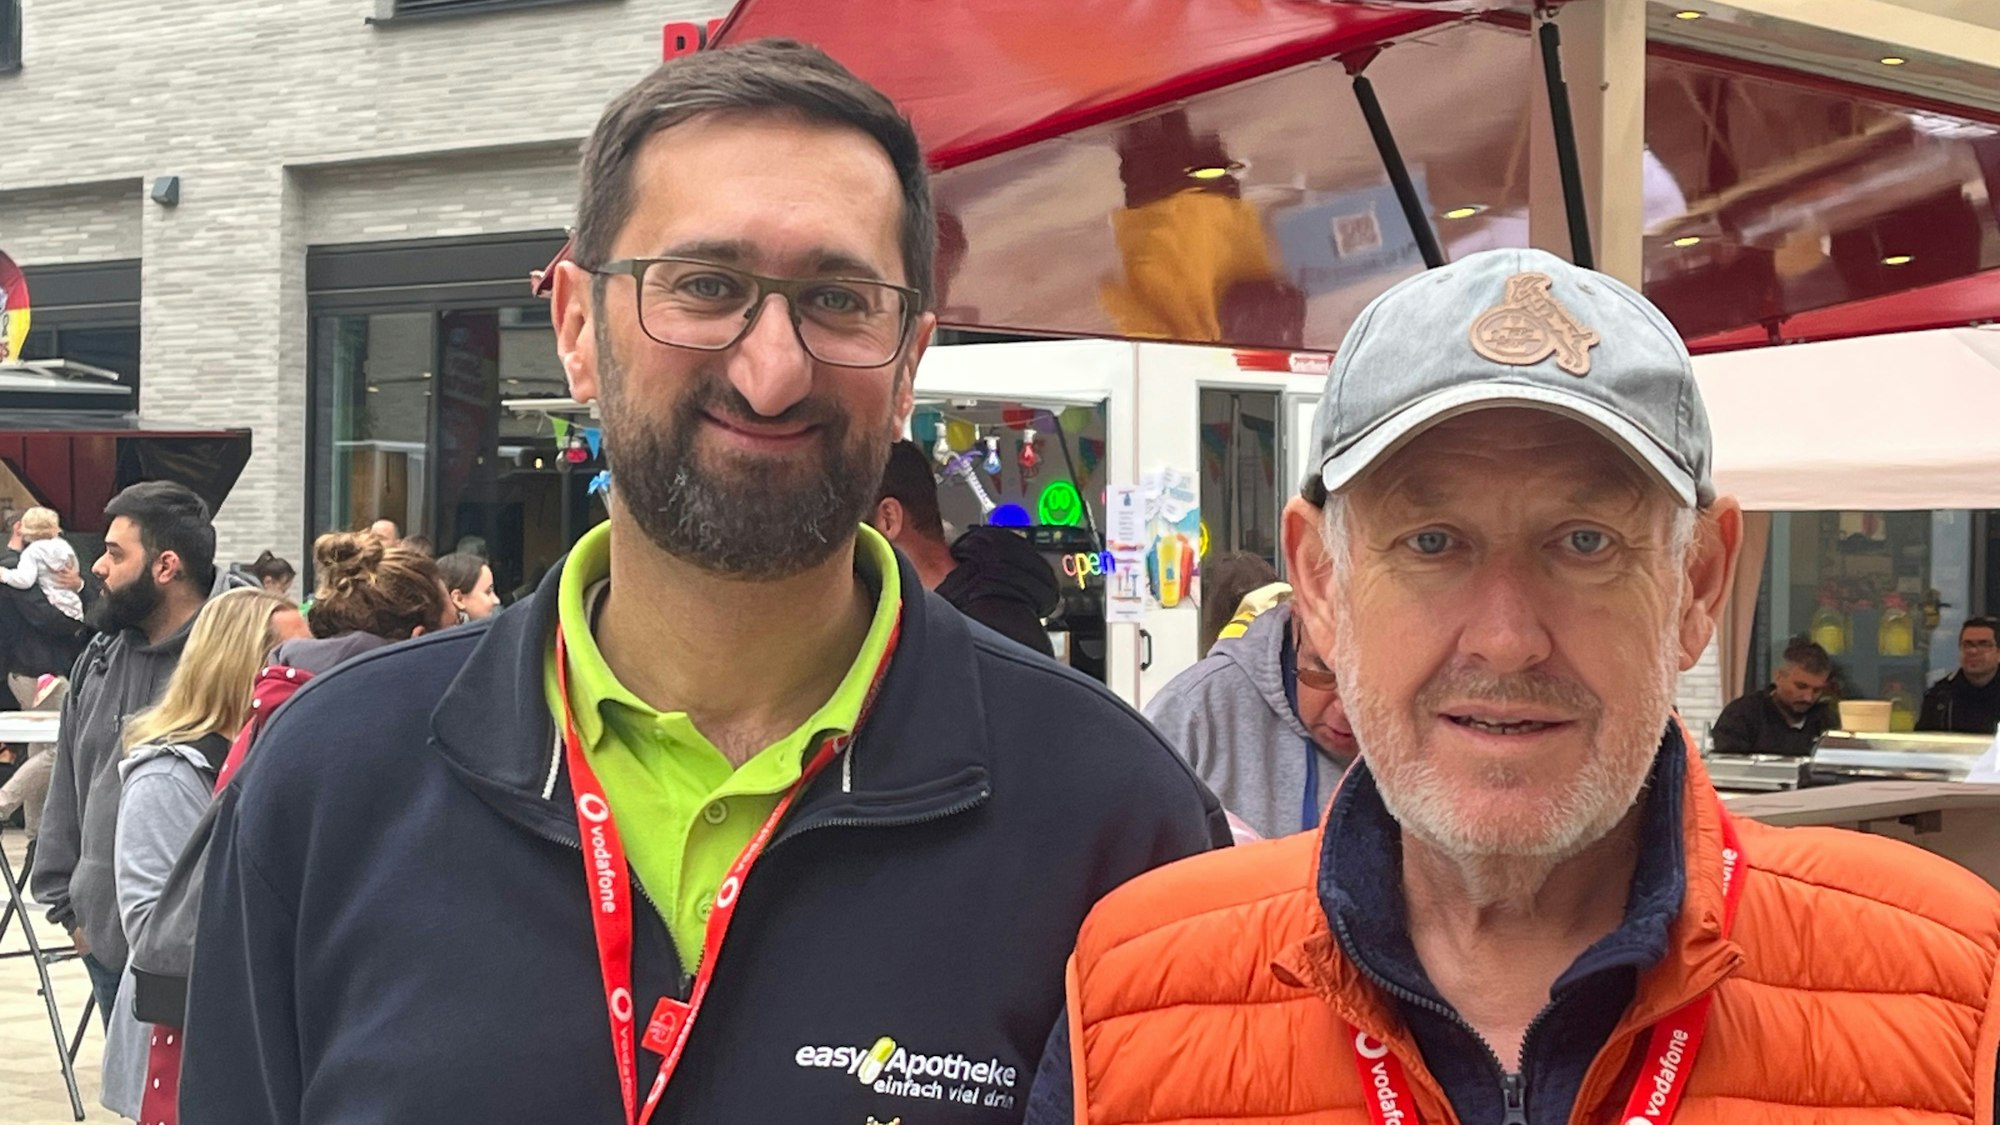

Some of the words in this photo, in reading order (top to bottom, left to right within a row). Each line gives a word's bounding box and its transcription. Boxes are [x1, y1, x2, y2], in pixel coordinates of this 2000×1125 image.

[1062, 550, 1116, 589] open
[590, 825, 616, 913] vodafone
[795, 1044, 869, 1075] easy
[884, 1046, 1017, 1087] Apotheke
[1645, 1029, 1689, 1116] vodafone
[873, 1074, 943, 1100] einfach
[949, 1083, 980, 1105] viel
